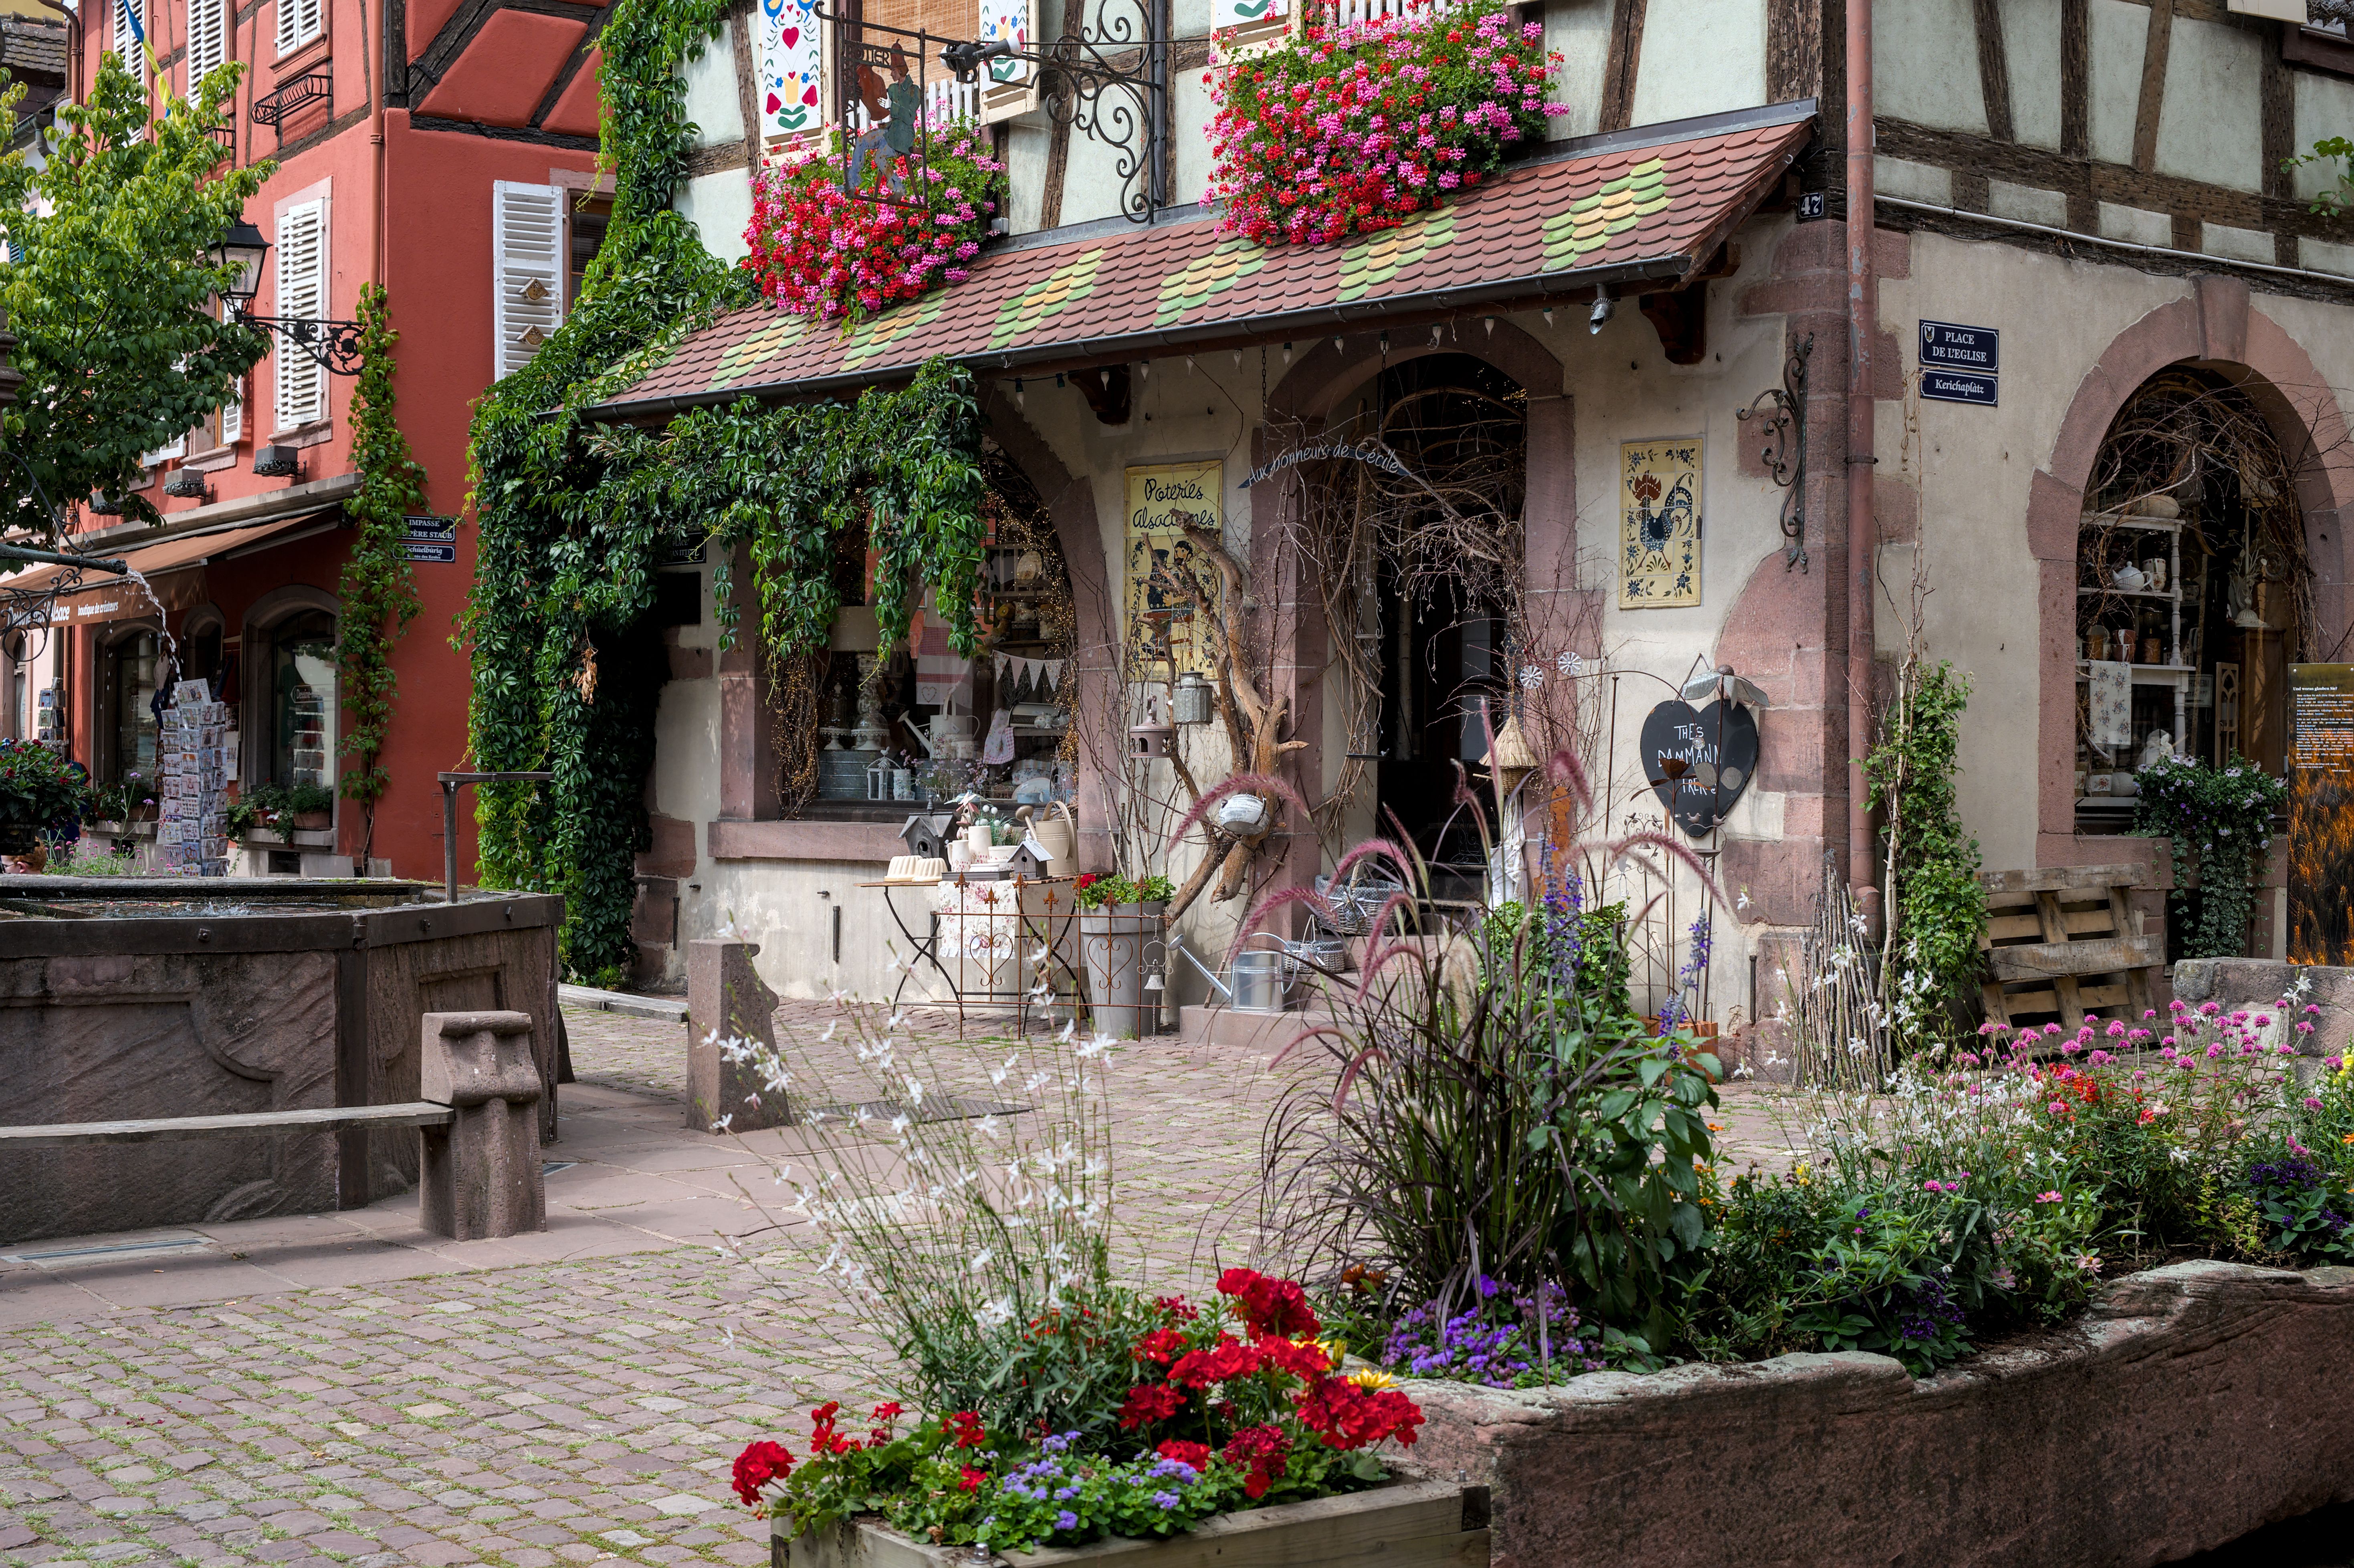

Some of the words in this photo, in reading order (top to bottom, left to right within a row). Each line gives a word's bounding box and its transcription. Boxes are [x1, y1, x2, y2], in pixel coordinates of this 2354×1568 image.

[1801, 196, 1821, 215] 47
[1945, 331, 1974, 345] PLACE
[1932, 346, 1945, 357] DE
[1948, 348, 1987, 362] L'EGLISE
[1935, 379, 1984, 396] Kerichaplàtz
[1249, 463, 1268, 486] Aux
[1333, 434, 1349, 458] de
[1355, 442, 1399, 473] Cécile
[1145, 478, 1203, 502] Poteries
[1133, 506, 1215, 530] Alsacines
[78, 603, 94, 618] boutique
[95, 602, 100, 614] de
[100, 600, 118, 613] créateurs
[1674, 723, 1704, 740] THES
